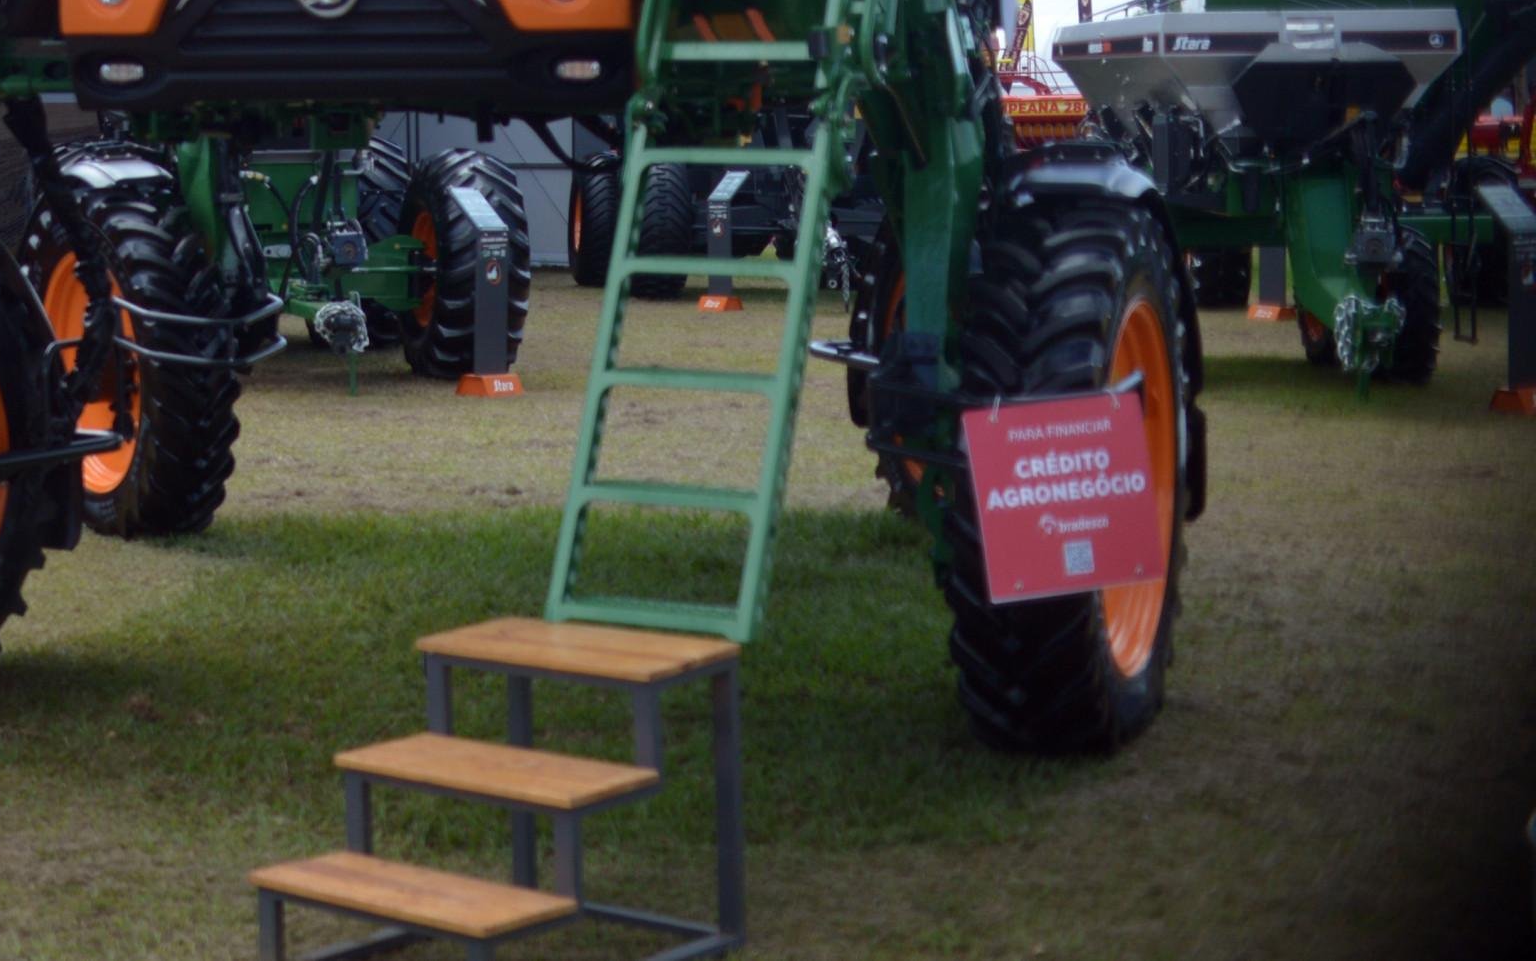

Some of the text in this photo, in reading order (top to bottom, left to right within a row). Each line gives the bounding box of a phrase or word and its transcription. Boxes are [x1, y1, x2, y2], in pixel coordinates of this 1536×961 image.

[1171, 36, 1211, 51] Stara
[493, 379, 514, 393] Stara
[1007, 417, 1113, 444] PARA FINANCIAR
[1015, 447, 1110, 480] CRÉDITO
[986, 472, 1147, 511] AGRONEGÓCIO
[1057, 515, 1109, 533] bradesco
